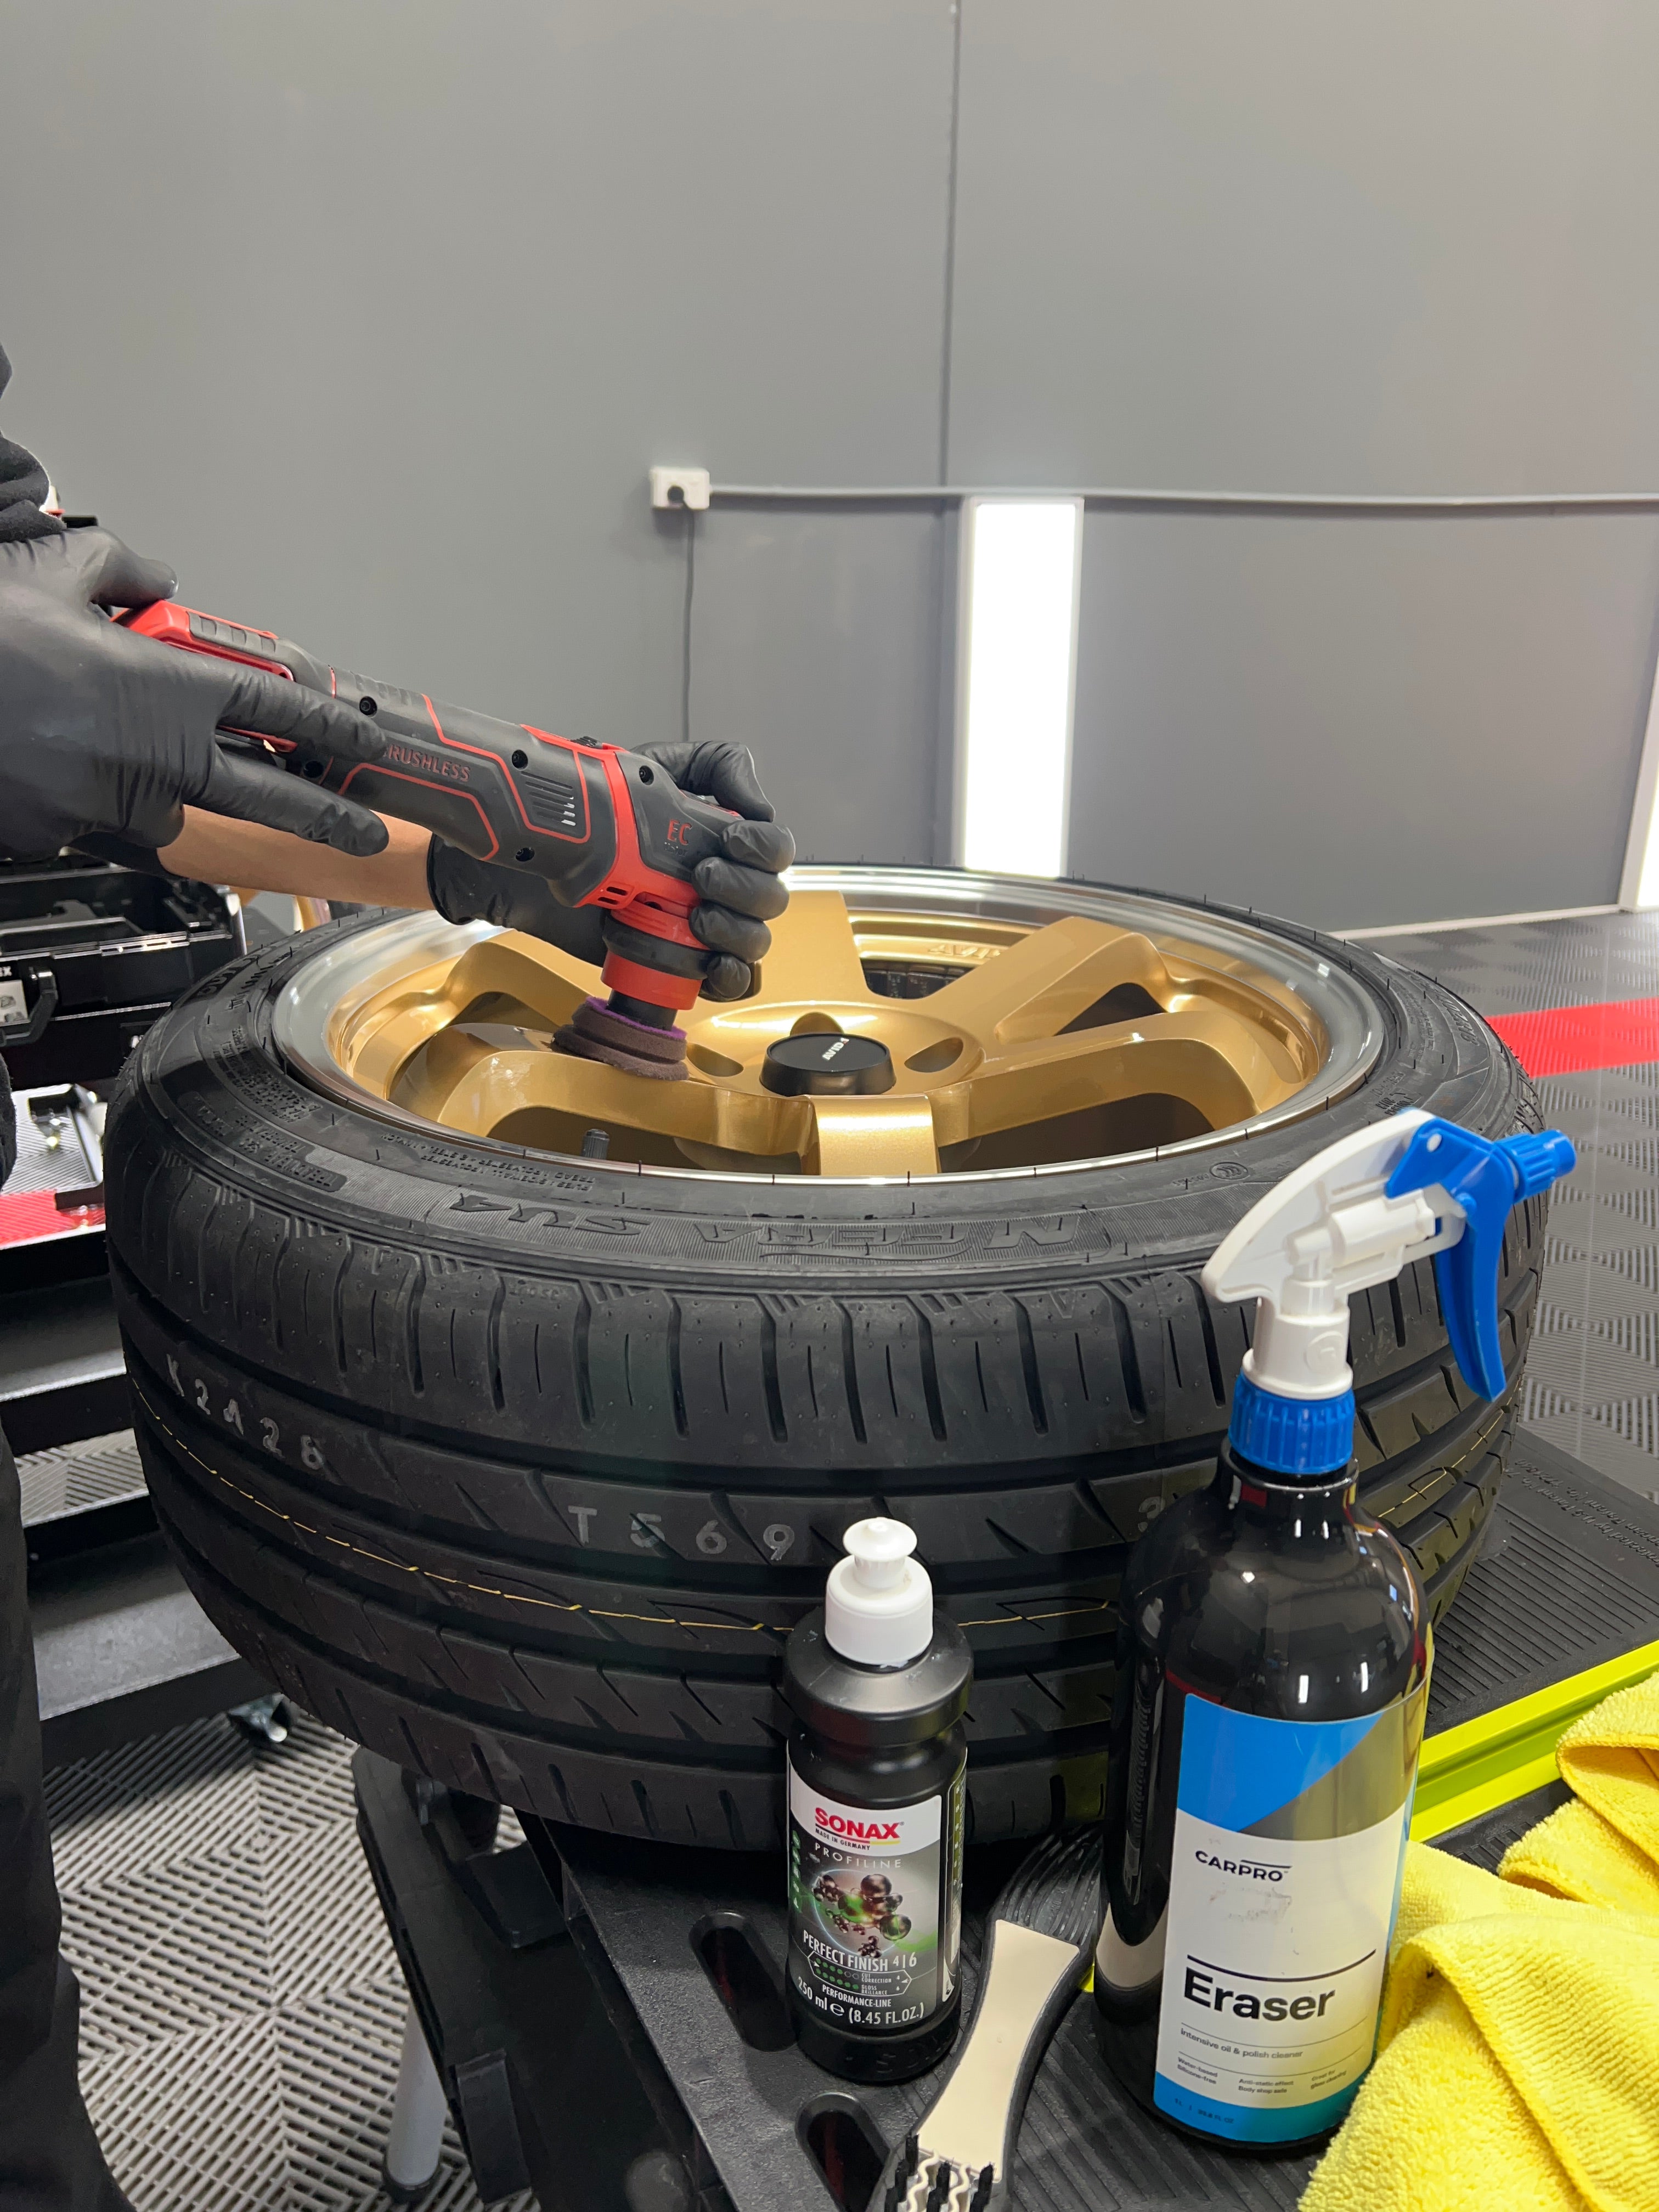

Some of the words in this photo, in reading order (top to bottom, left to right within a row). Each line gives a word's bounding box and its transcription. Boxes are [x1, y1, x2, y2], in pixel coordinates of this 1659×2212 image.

[382, 743, 471, 782] RUSHLESS
[668, 819, 692, 845] EC
[815, 1807, 901, 1839] SONAX
[815, 1828, 830, 1840] MADE
[840, 1839, 870, 1850] GERMANY
[815, 1842, 901, 1869] PROFILINE
[1195, 1850, 1283, 1882] CARPRO
[803, 1929, 845, 1965] PERFECT
[848, 1954, 888, 1972] FINISH
[798, 1976, 813, 2000] 250
[815, 1994, 827, 2010] ml
[849, 2007, 881, 2024] (8.45
[822, 1984, 891, 2007] PERFORMANCE-LINE
[1184, 1966, 1335, 2021] Eraser
[1181, 2028, 1219, 2049] intensive
[1243, 2050, 1269, 2058] polish
